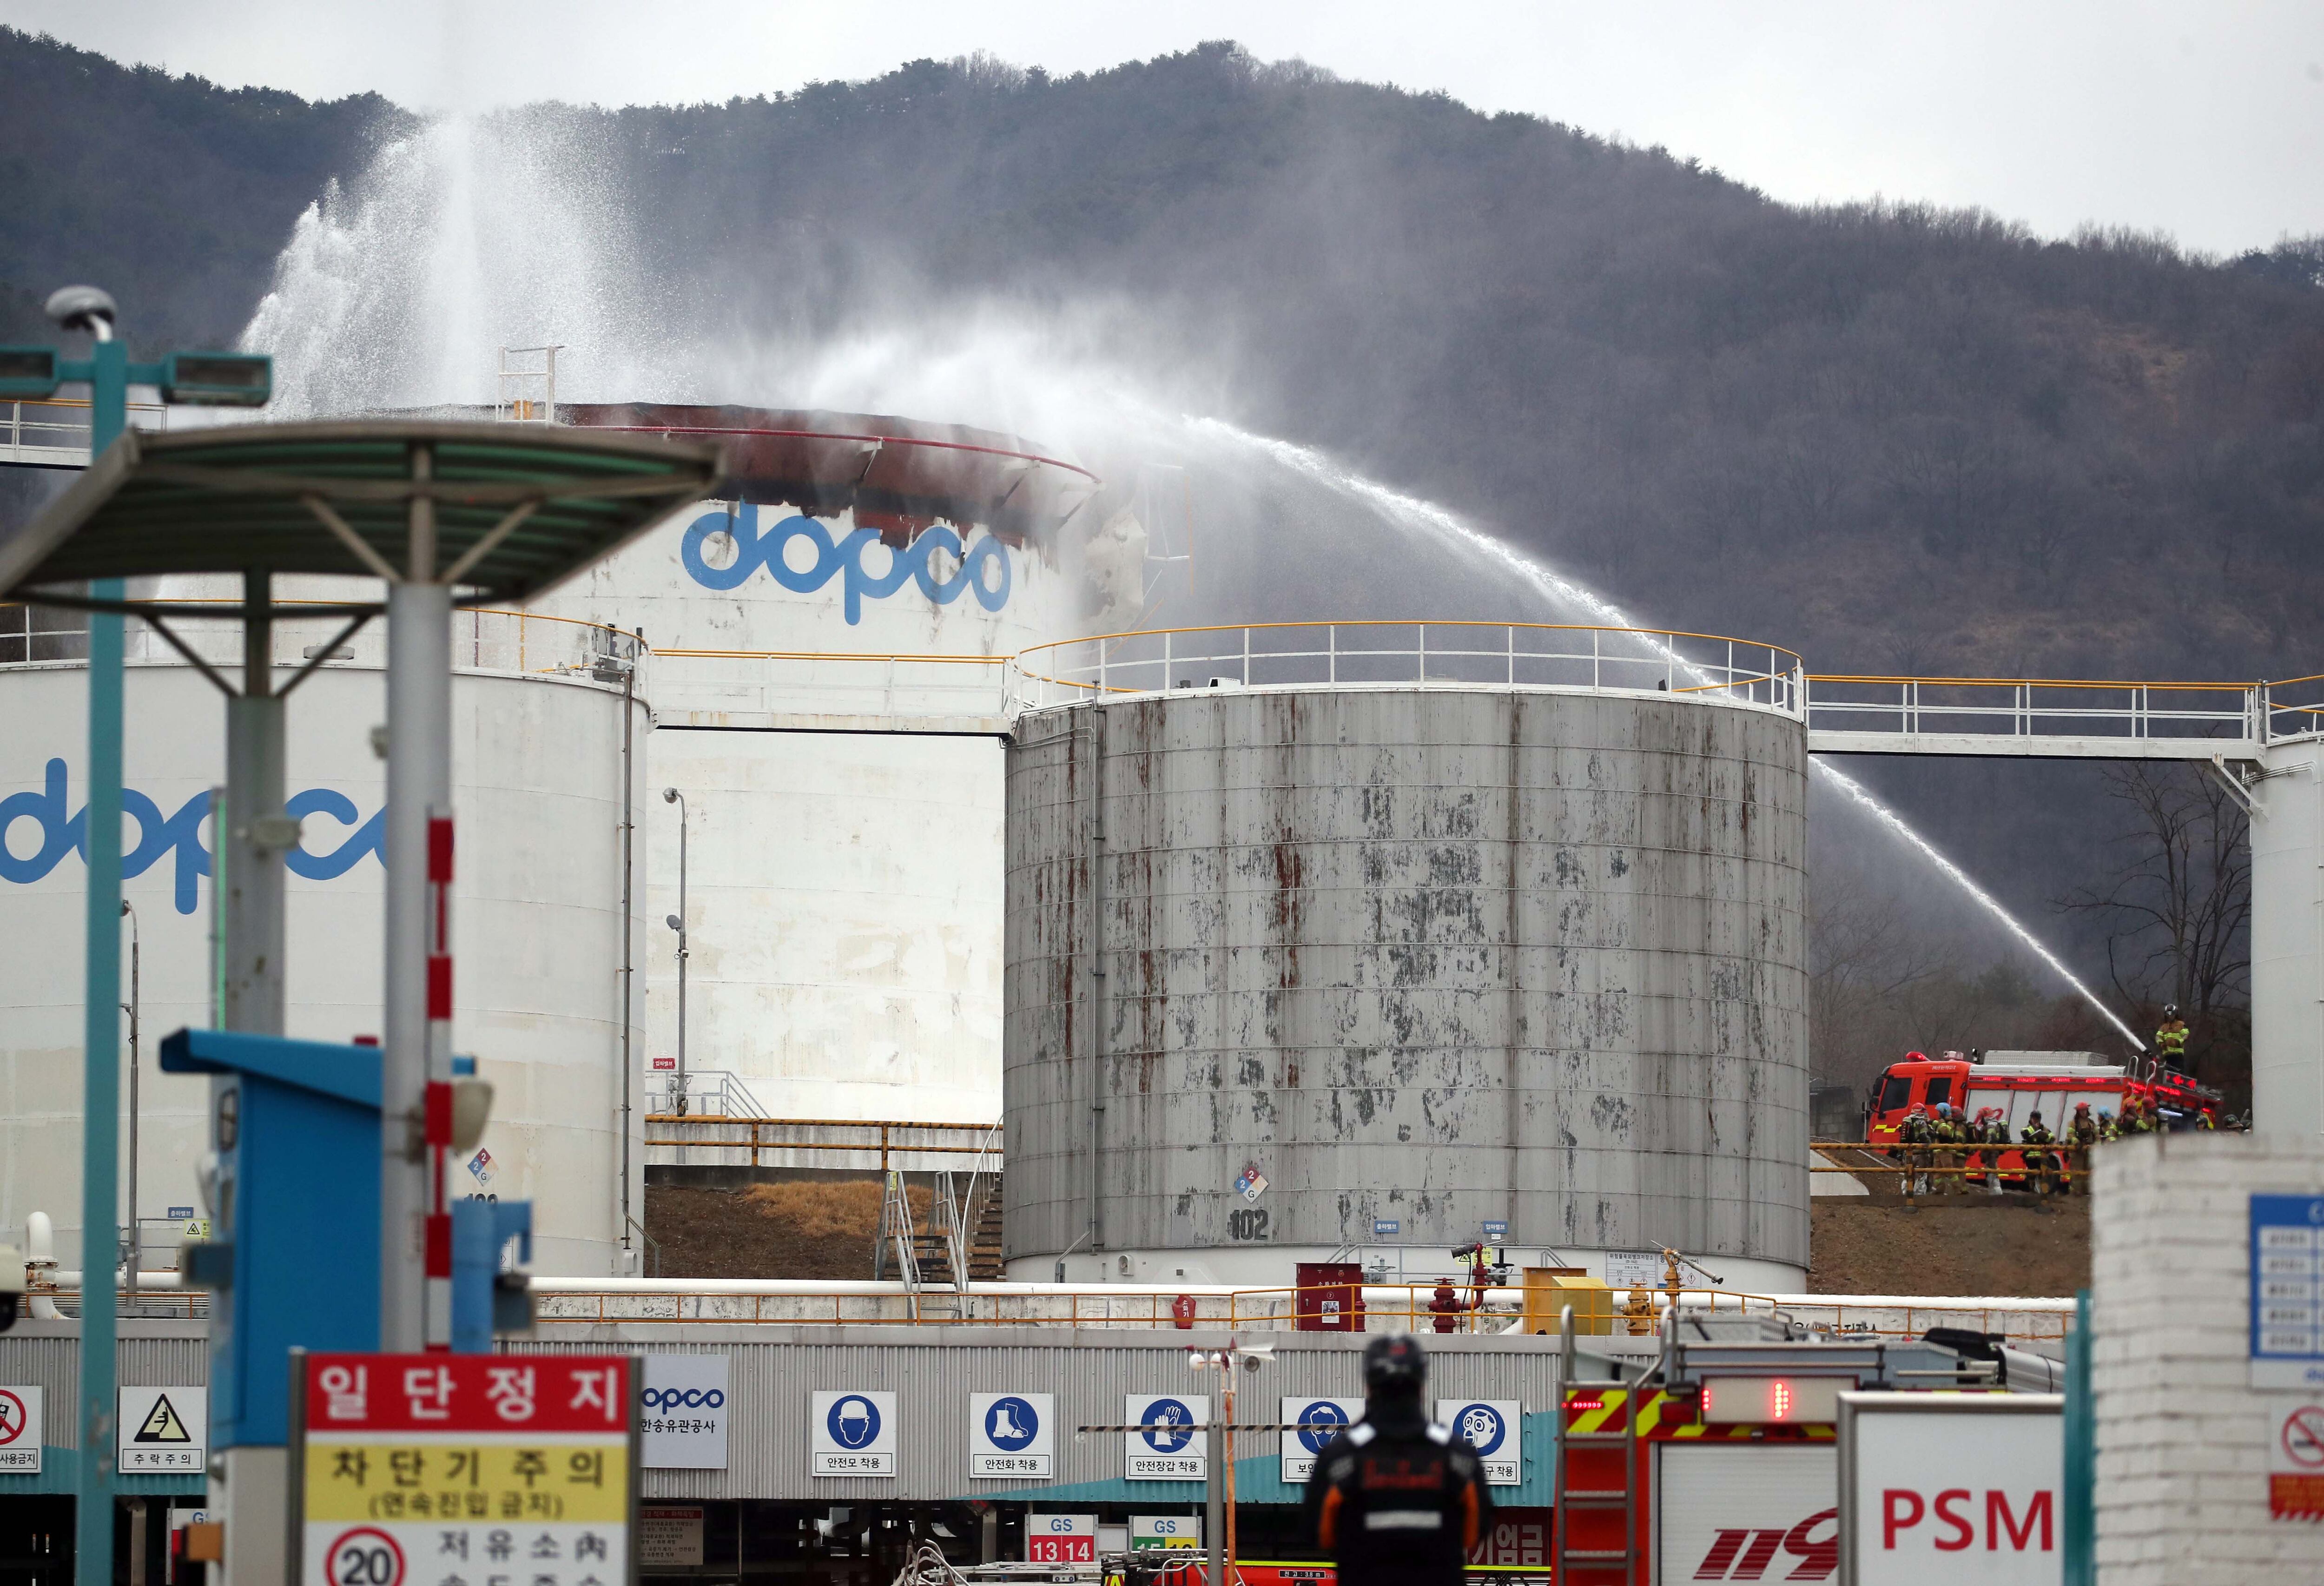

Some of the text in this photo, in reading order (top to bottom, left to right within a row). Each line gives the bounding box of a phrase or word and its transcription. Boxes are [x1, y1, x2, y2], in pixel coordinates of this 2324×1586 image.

[681, 495, 1011, 625] dopco
[0, 758, 453, 914] dopc
[481, 1153, 486, 1161] 2
[473, 1162, 478, 1170] 2
[1248, 1170, 1254, 1179] 2
[1240, 1180, 1245, 1189] 2
[1230, 1209, 1268, 1240] 102
[827, 1457, 880, 1469] 안전모 착용
[985, 1459, 1037, 1470] 안전화 착용
[1136, 1460, 1198, 1472] 안전장갑 착용
[1497, 1466, 1513, 1477] 착용
[1051, 1518, 1073, 1532] GS
[1154, 1520, 1176, 1533] GS
[1882, 1489, 2053, 1552] PSM
[1463, 1524, 1543, 1565] 기엄금
[1693, 1507, 1838, 1580] 119
[1034, 1541, 1089, 1560] 13 14
[341, 1547, 392, 1585] 20
